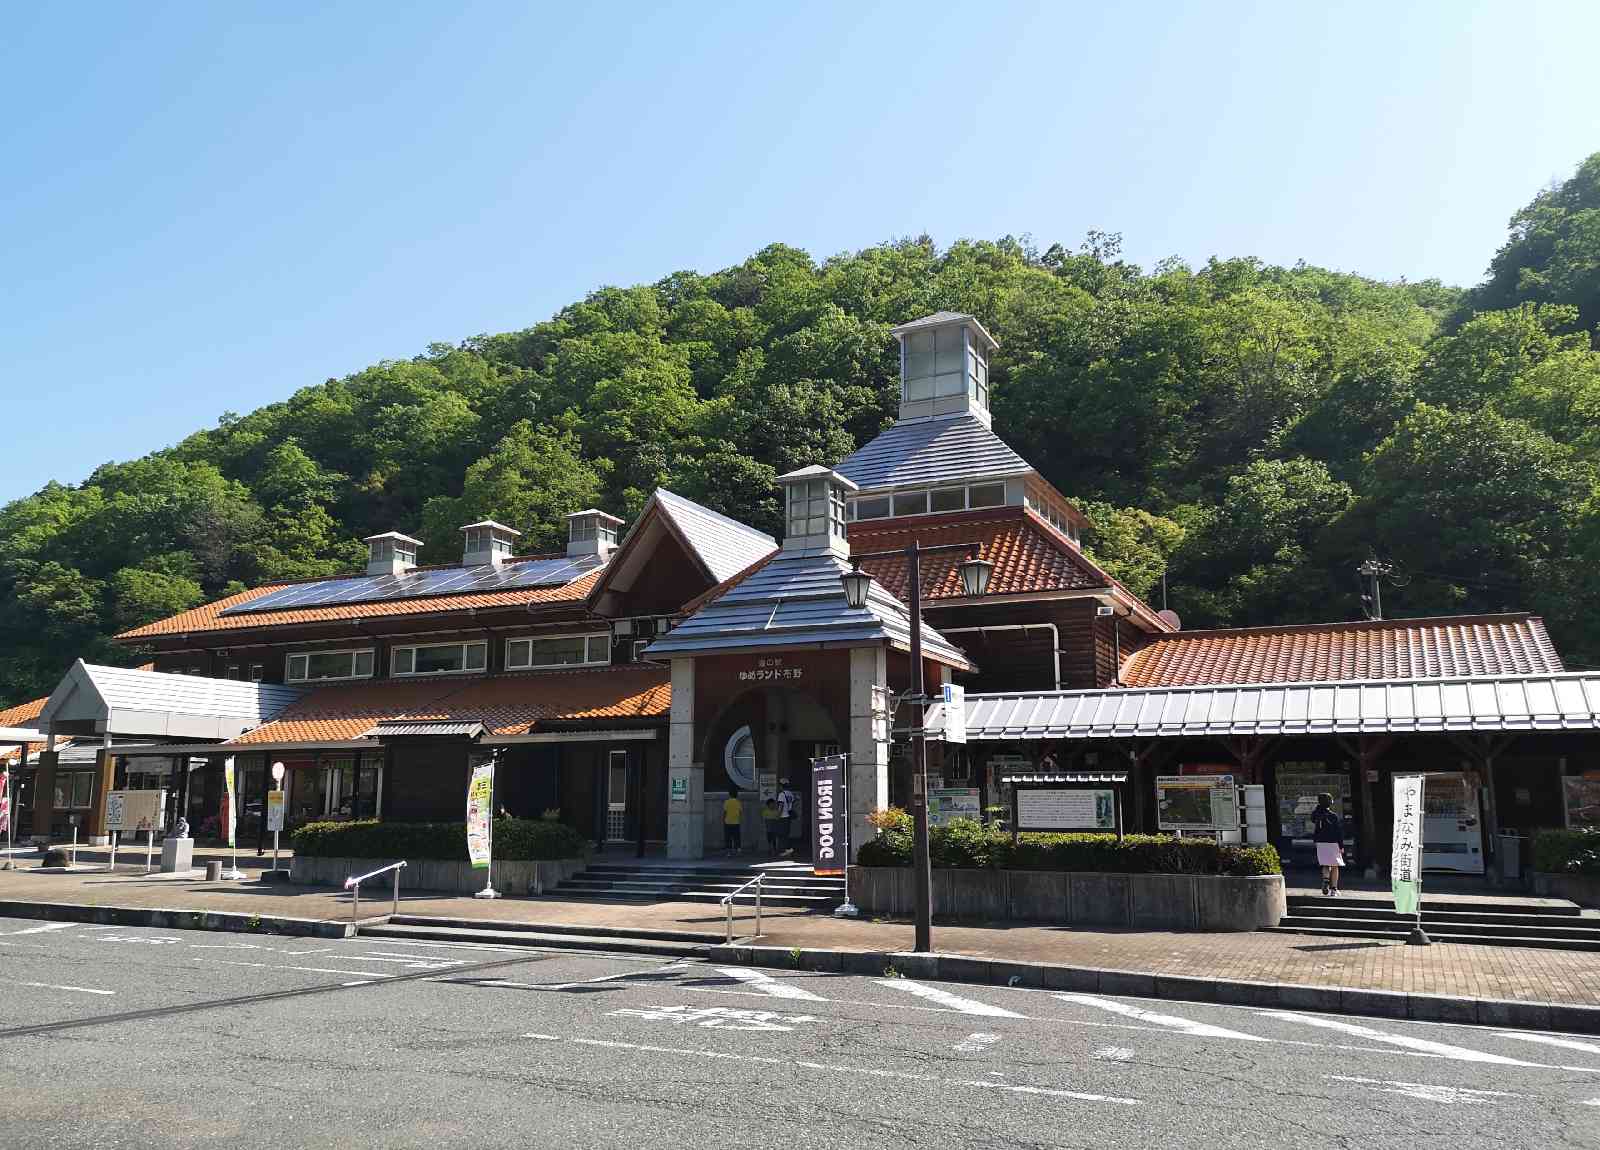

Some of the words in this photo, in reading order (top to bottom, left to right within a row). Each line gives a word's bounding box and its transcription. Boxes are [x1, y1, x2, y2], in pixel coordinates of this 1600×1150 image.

[739, 668, 804, 681] ゆめランド布野
[1400, 787, 1417, 882] やまなみ街道
